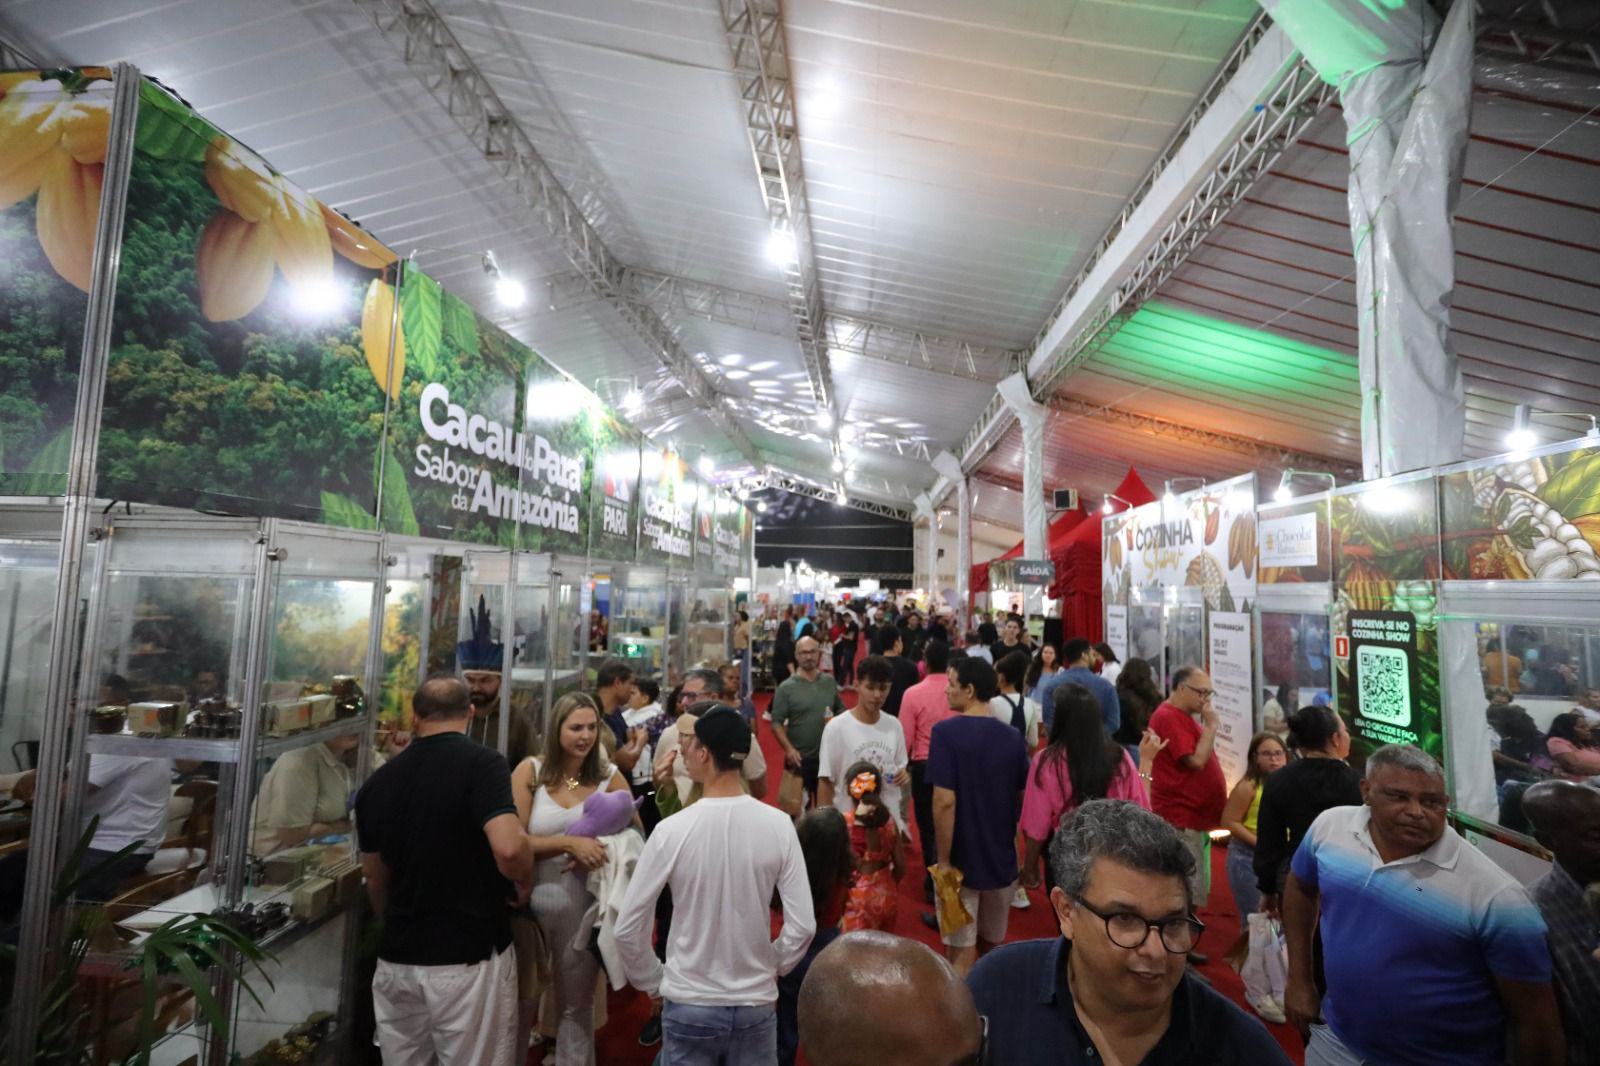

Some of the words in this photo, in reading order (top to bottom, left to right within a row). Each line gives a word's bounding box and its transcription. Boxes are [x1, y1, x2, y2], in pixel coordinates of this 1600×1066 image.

[420, 382, 524, 468] Cacau
[533, 434, 584, 493] Pará
[414, 444, 480, 490] Sabor
[451, 487, 468, 511] da
[469, 470, 579, 533] Amazônia
[1136, 518, 1193, 551] COZINHA
[1019, 564, 1050, 576] SAÍDA
[1352, 618, 1395, 630] INSCREVA-SE
[1396, 621, 1410, 631] NO
[1352, 629, 1385, 641] COZINHA
[1385, 631, 1411, 643] SHOW
